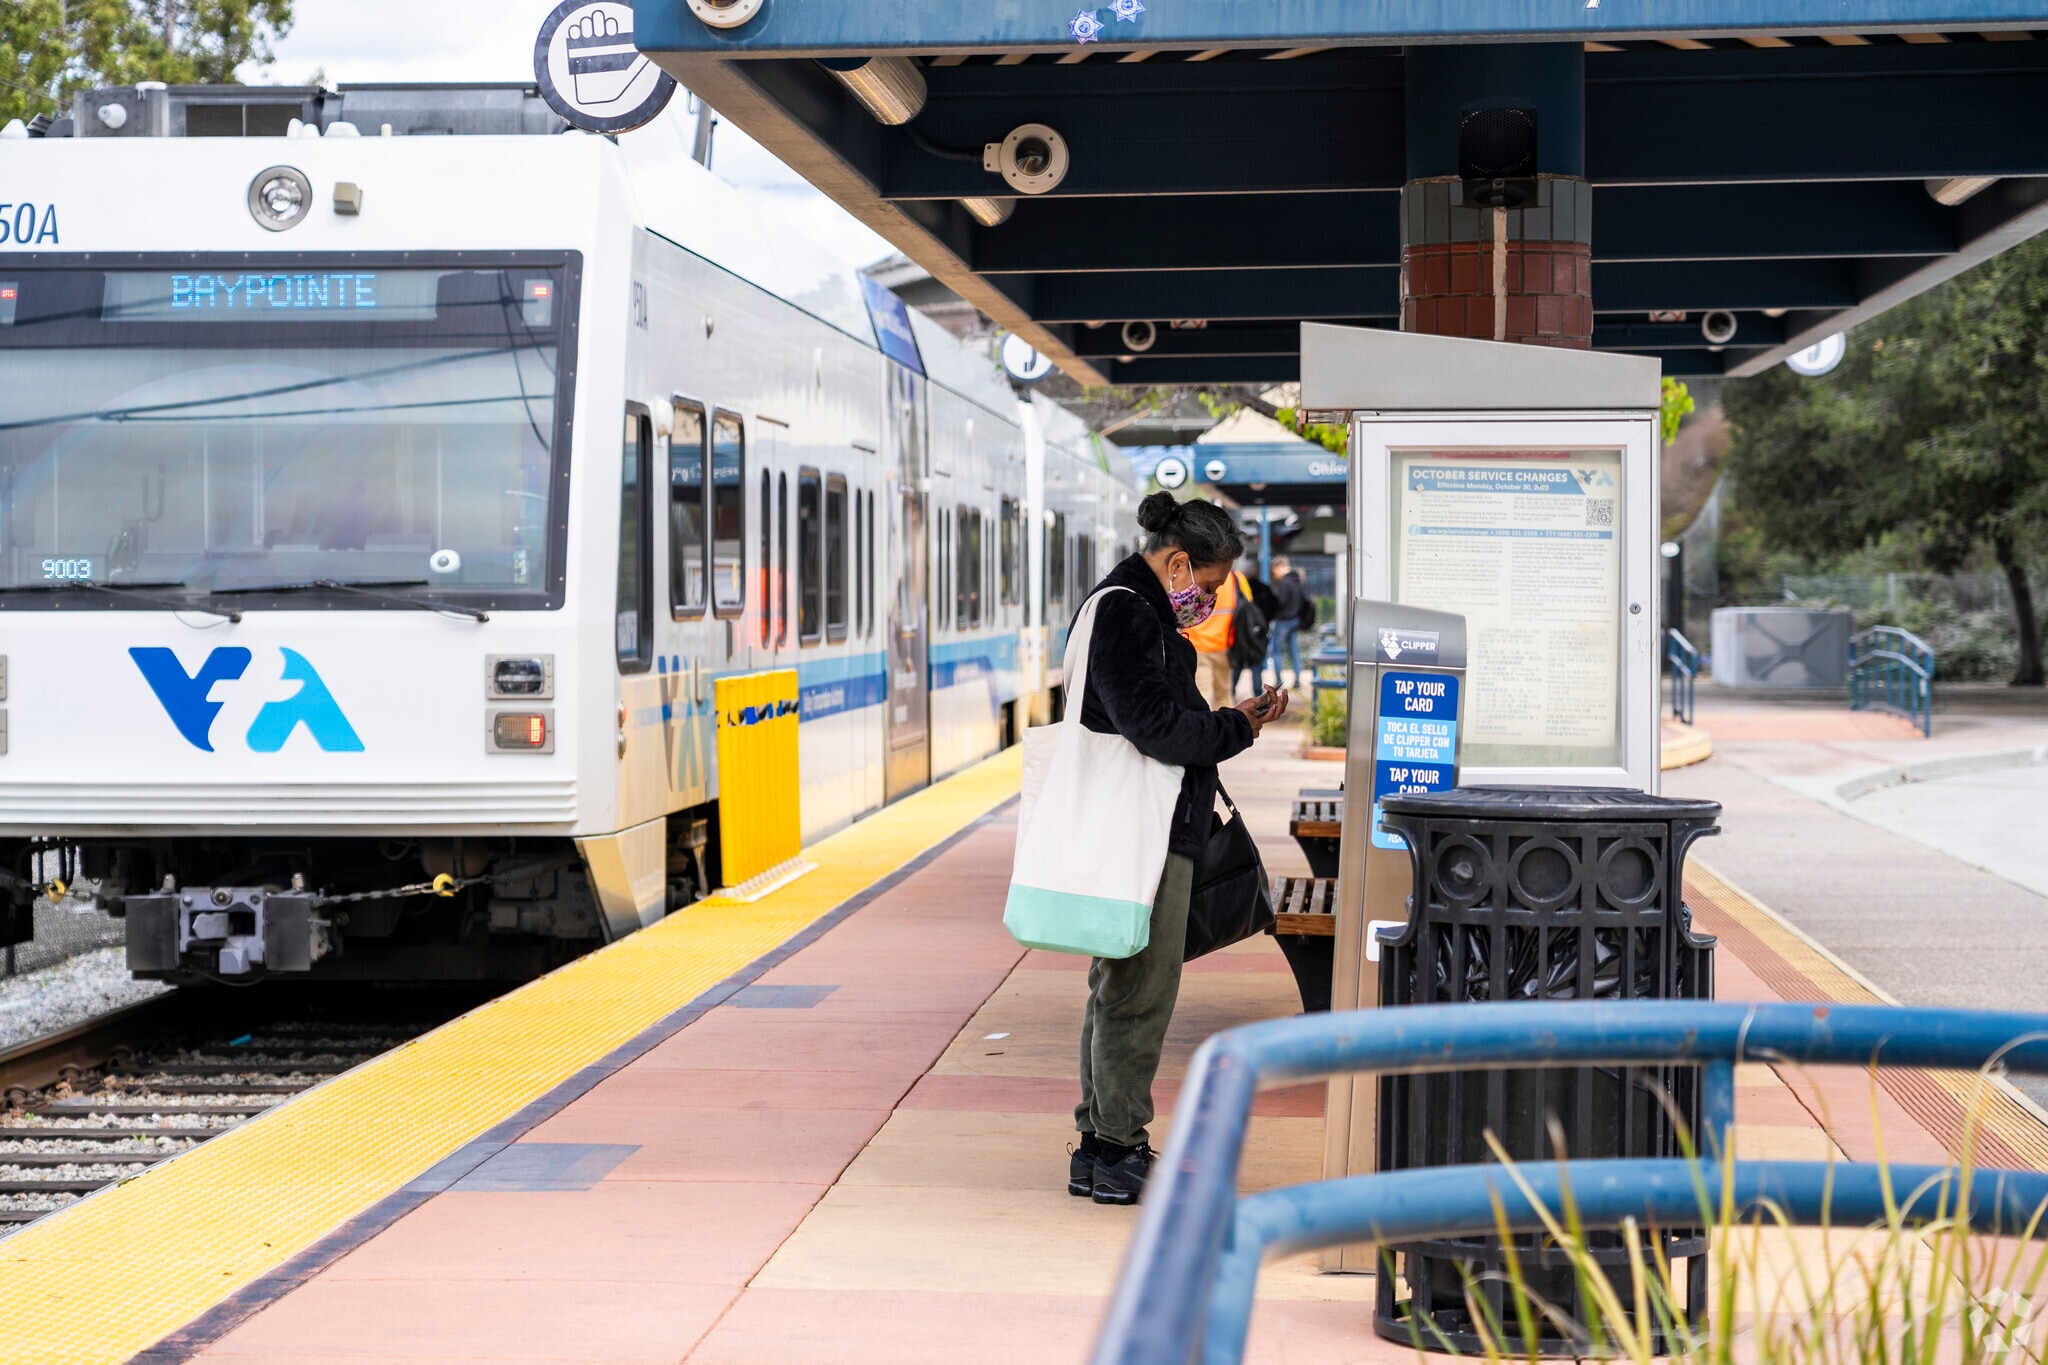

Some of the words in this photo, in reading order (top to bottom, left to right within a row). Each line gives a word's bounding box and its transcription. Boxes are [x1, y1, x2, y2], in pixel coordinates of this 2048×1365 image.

[171, 274, 376, 307] BAYPOINTE
[1413, 469, 1465, 480] OCTOBER
[1468, 471, 1513, 482] SERVICE
[1515, 472, 1568, 483] CHANGES
[1437, 481, 1465, 489] Effective
[1467, 482, 1494, 491] Monday,
[1545, 530, 1556, 538] TTY
[42, 559, 92, 579] 9003
[1401, 641, 1436, 651] CLIPPER
[1395, 680, 1414, 694] TAP
[1416, 681, 1445, 696] YOUR
[1404, 697, 1433, 712] CARD
[1387, 722, 1407, 733] TOCA
[1410, 723, 1419, 734] EL
[1422, 724, 1448, 735] SELLO
[1384, 734, 1395, 745] DE
[1396, 735, 1430, 747] CLIPPER
[1432, 737, 1449, 748] CON
[1393, 746, 1403, 757] TU
[1405, 747, 1438, 759] TARJETA
[1389, 767, 1409, 782] TAP
[1411, 769, 1440, 784] YOUR
